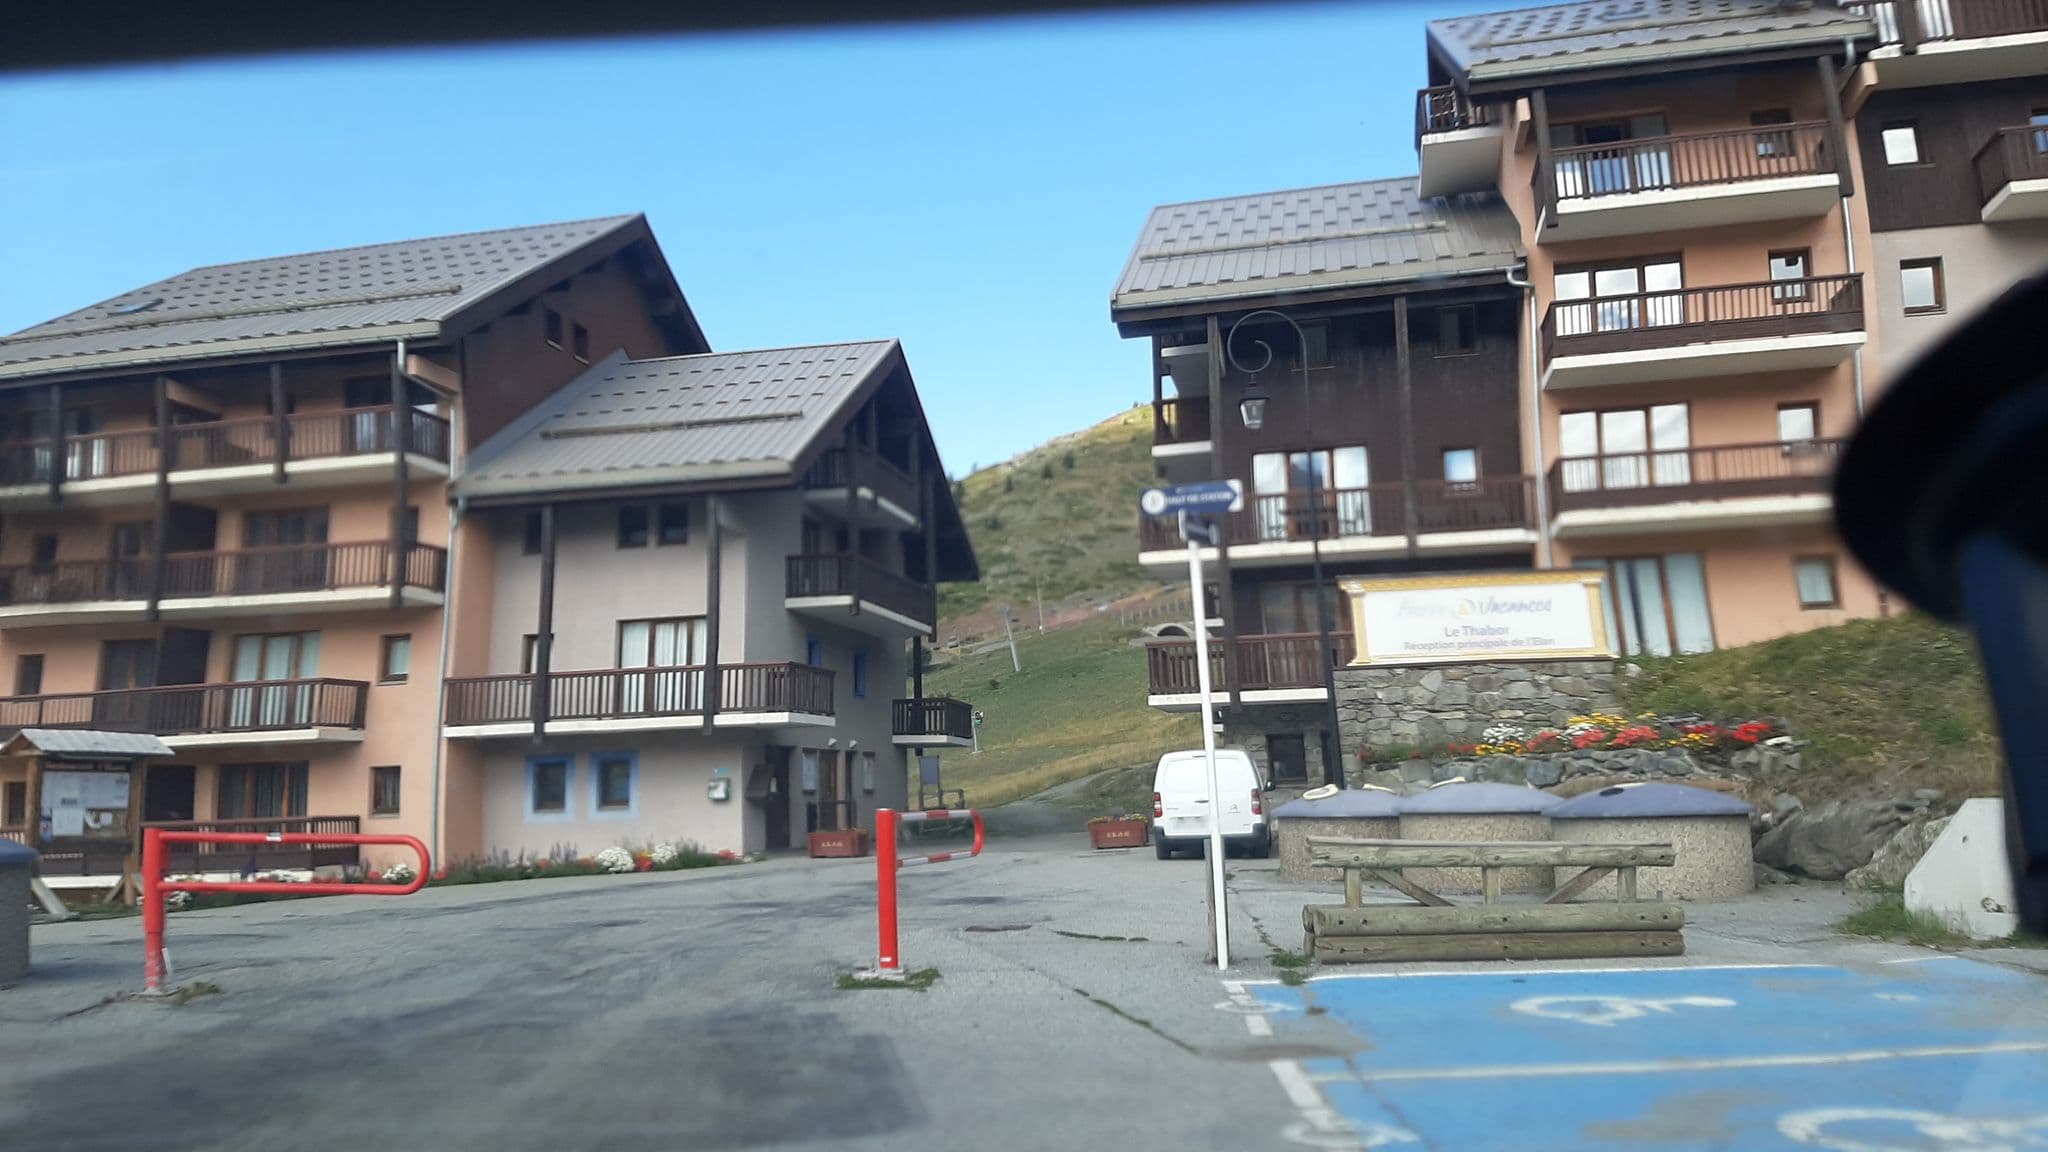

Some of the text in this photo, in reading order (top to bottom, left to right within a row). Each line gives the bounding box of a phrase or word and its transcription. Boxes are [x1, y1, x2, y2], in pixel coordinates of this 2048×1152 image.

[1444, 624, 1509, 638] Le Thabor
[1457, 637, 1510, 650] principale
